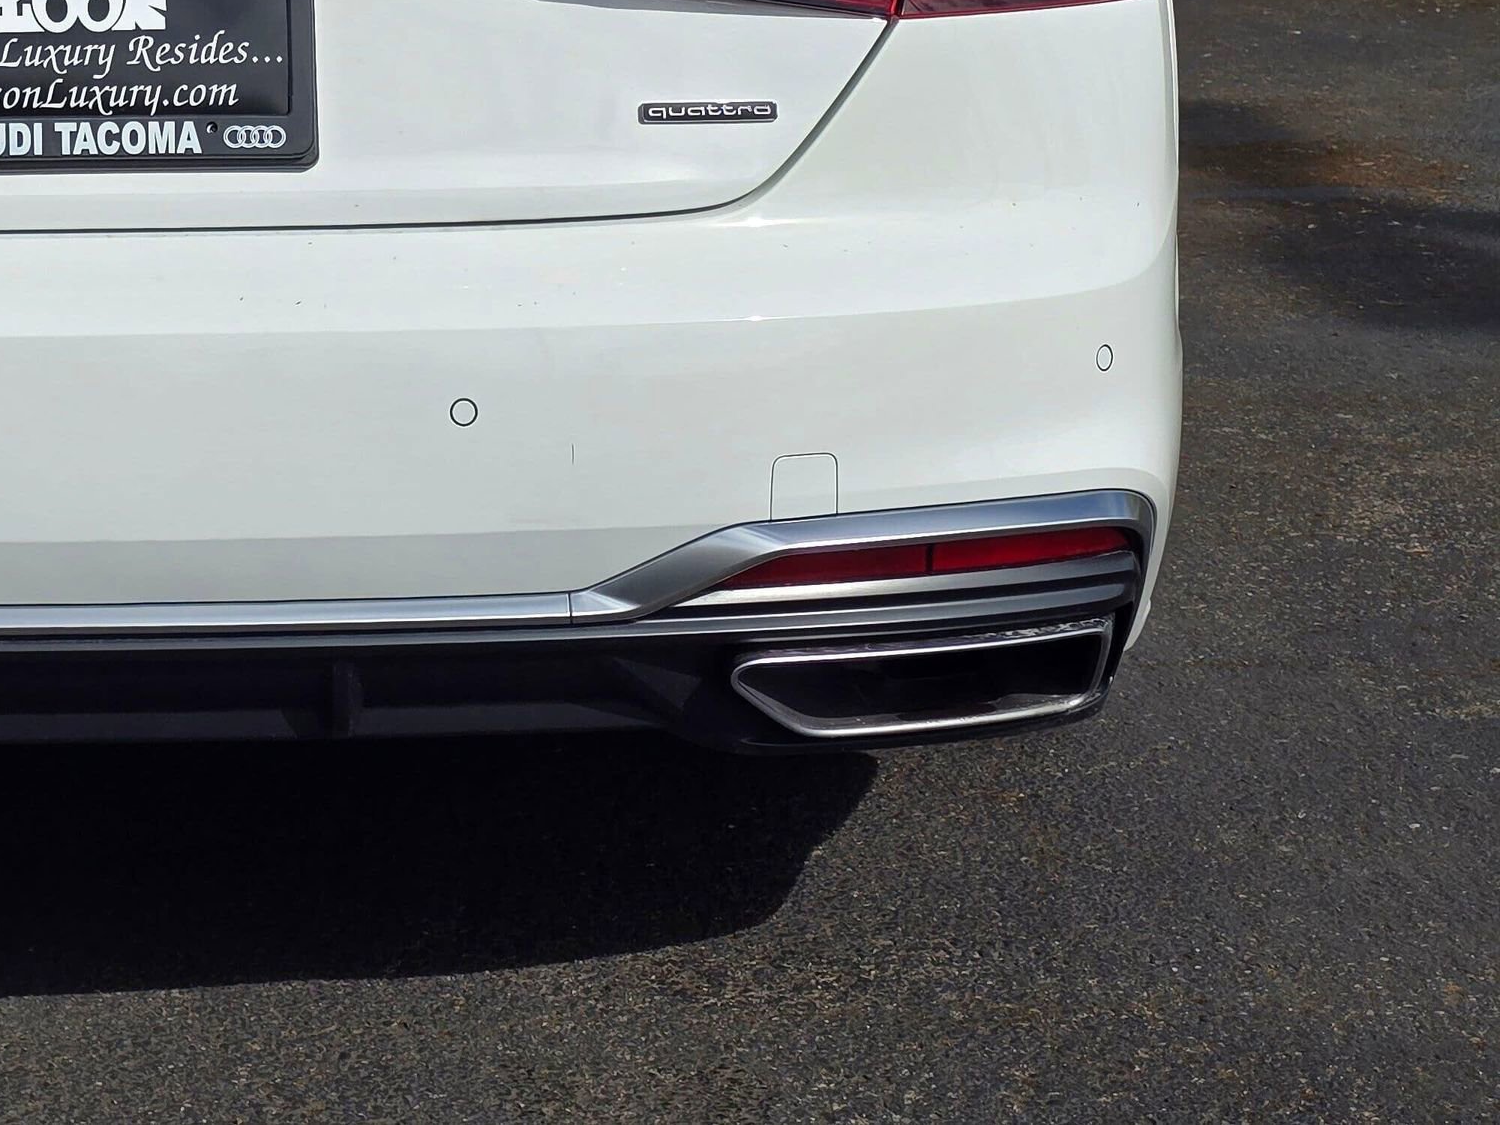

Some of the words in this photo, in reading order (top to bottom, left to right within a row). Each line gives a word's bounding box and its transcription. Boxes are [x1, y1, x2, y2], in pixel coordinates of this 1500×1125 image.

[127, 29, 284, 72] Resides...
[648, 103, 772, 120] quattro
[54, 120, 203, 156] TACOMA
